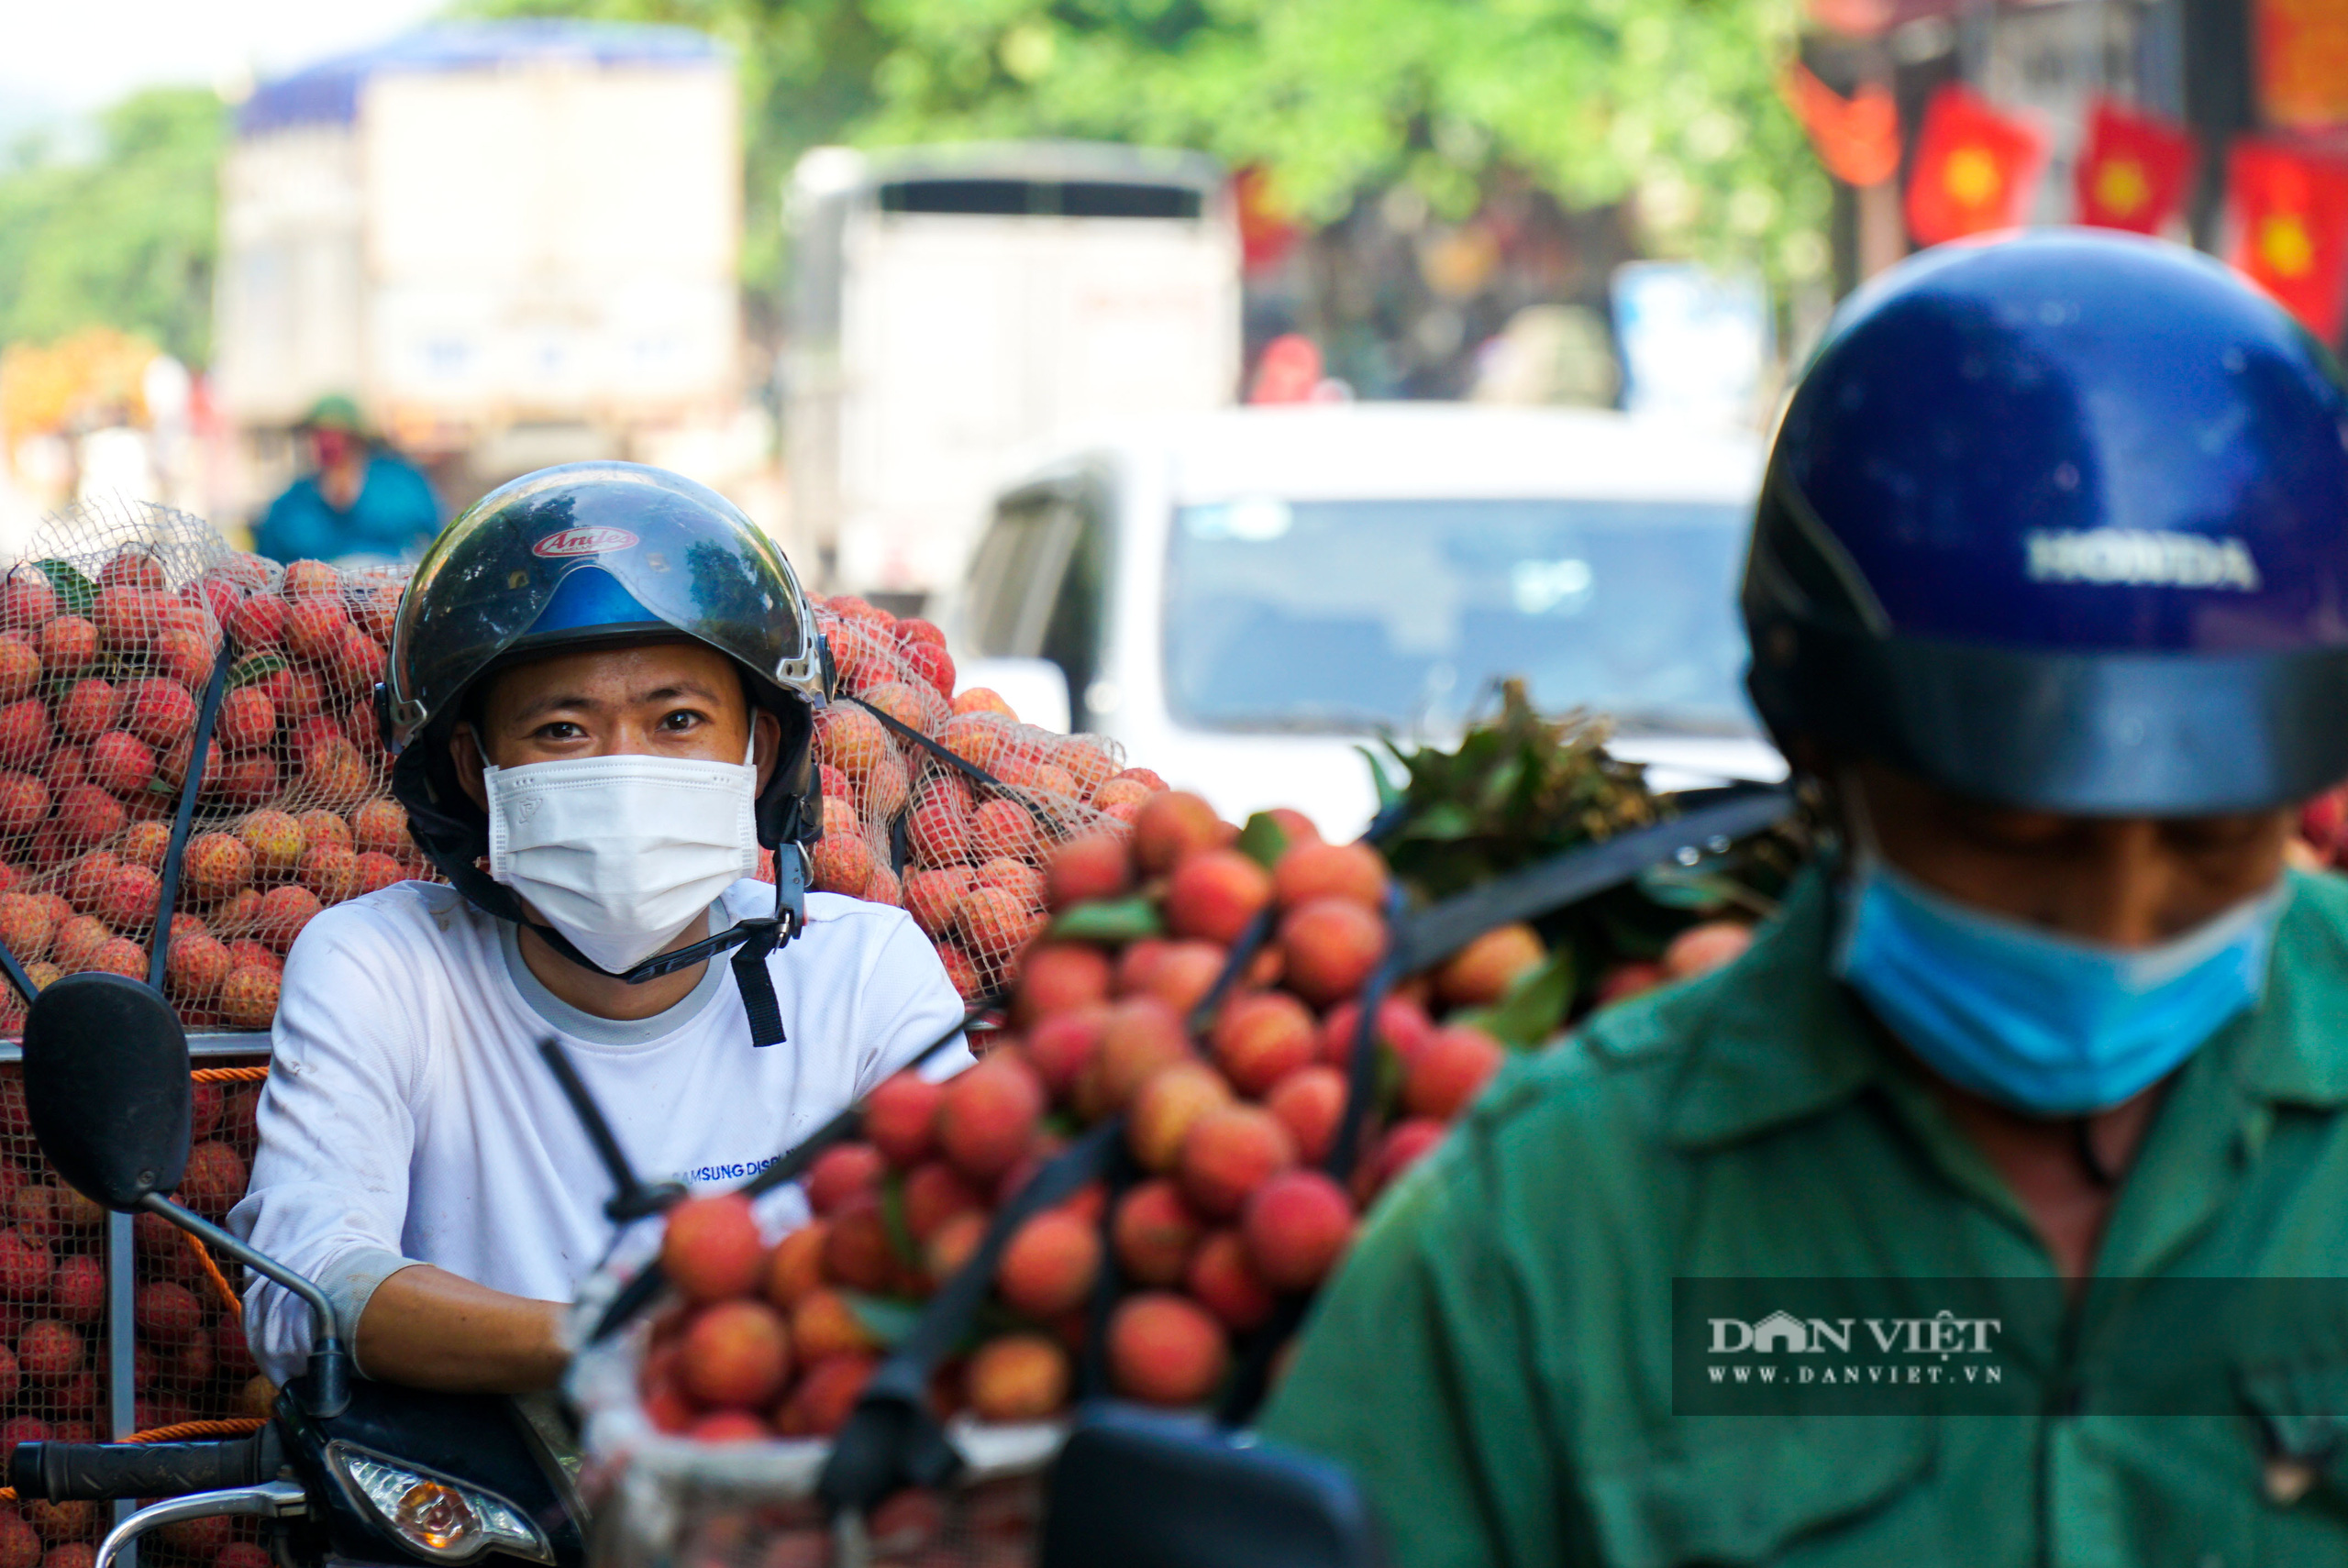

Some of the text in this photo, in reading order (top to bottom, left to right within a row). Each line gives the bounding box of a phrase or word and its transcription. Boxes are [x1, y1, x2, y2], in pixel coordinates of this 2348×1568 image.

[543, 531, 636, 552] Andes
[2025, 527, 2260, 591] HONDA
[747, 1148, 795, 1176] DISP
